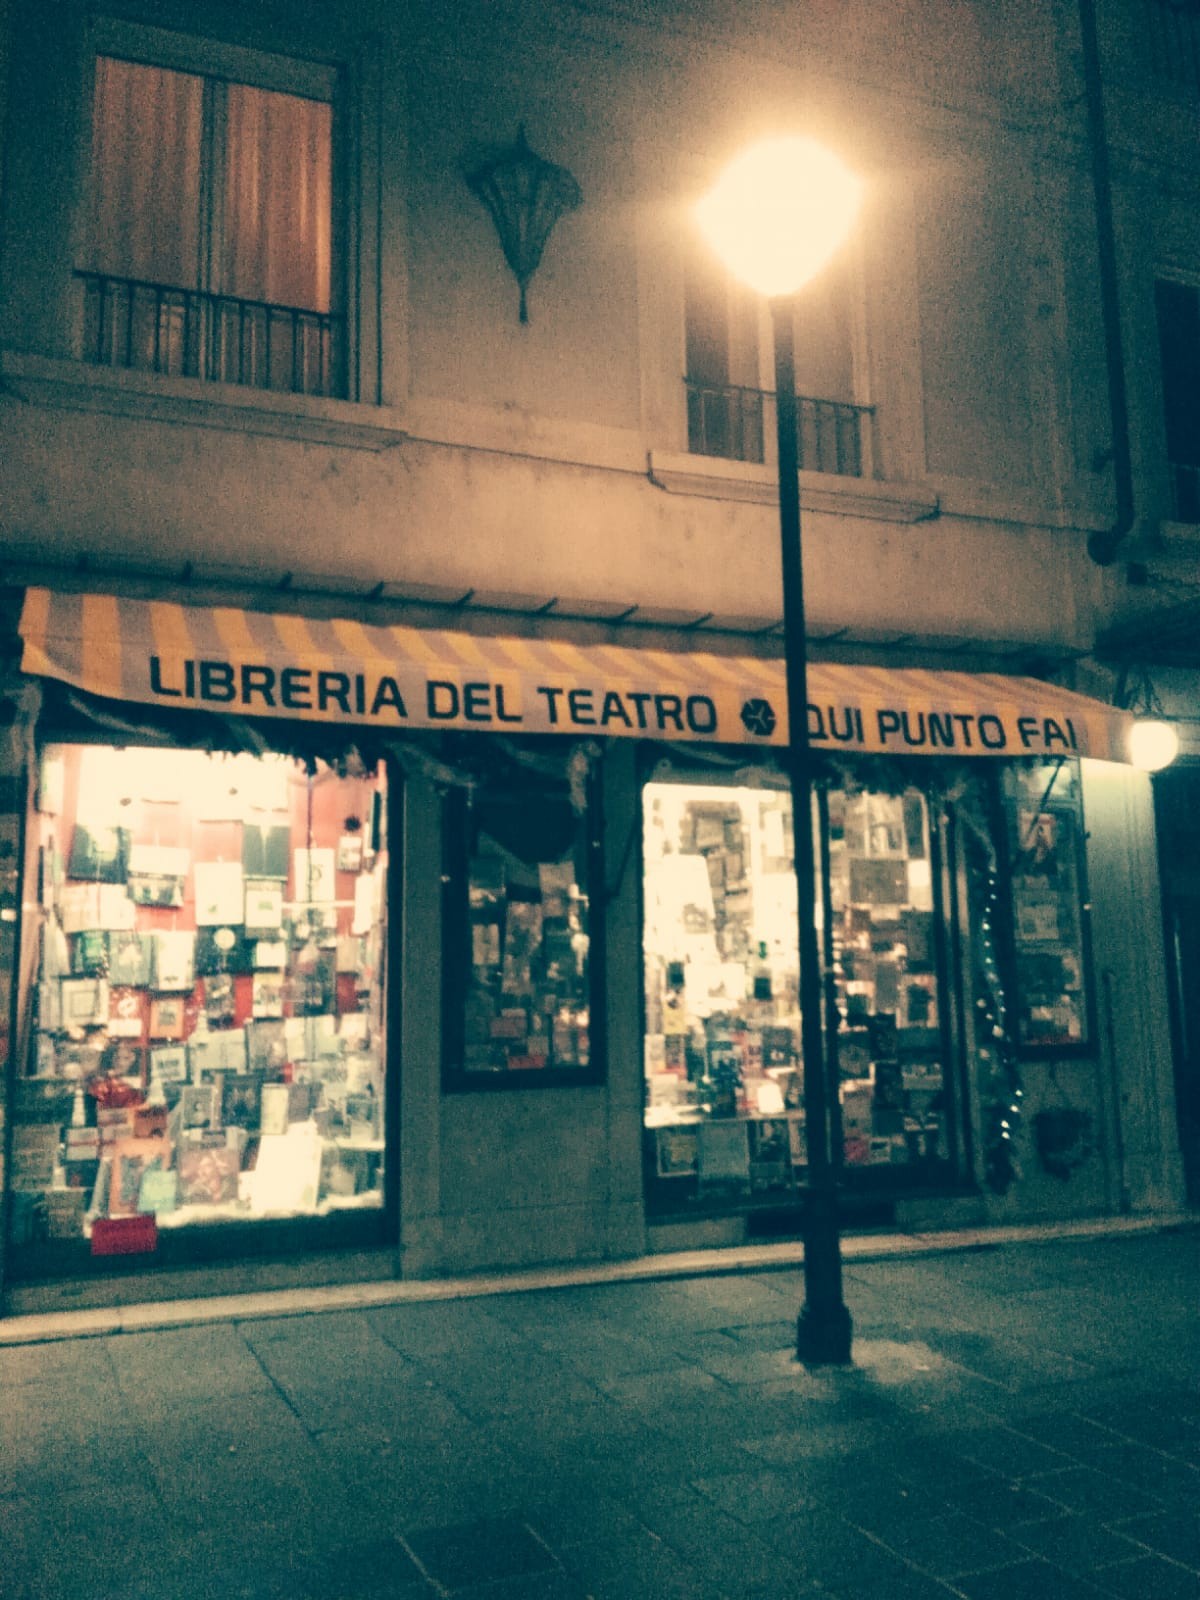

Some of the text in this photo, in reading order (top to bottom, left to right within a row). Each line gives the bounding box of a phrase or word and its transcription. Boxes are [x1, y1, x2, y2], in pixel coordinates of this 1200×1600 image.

[150, 656, 1077, 750] LIBRERIA DEL TEATRO QUI PUNTO FAI
